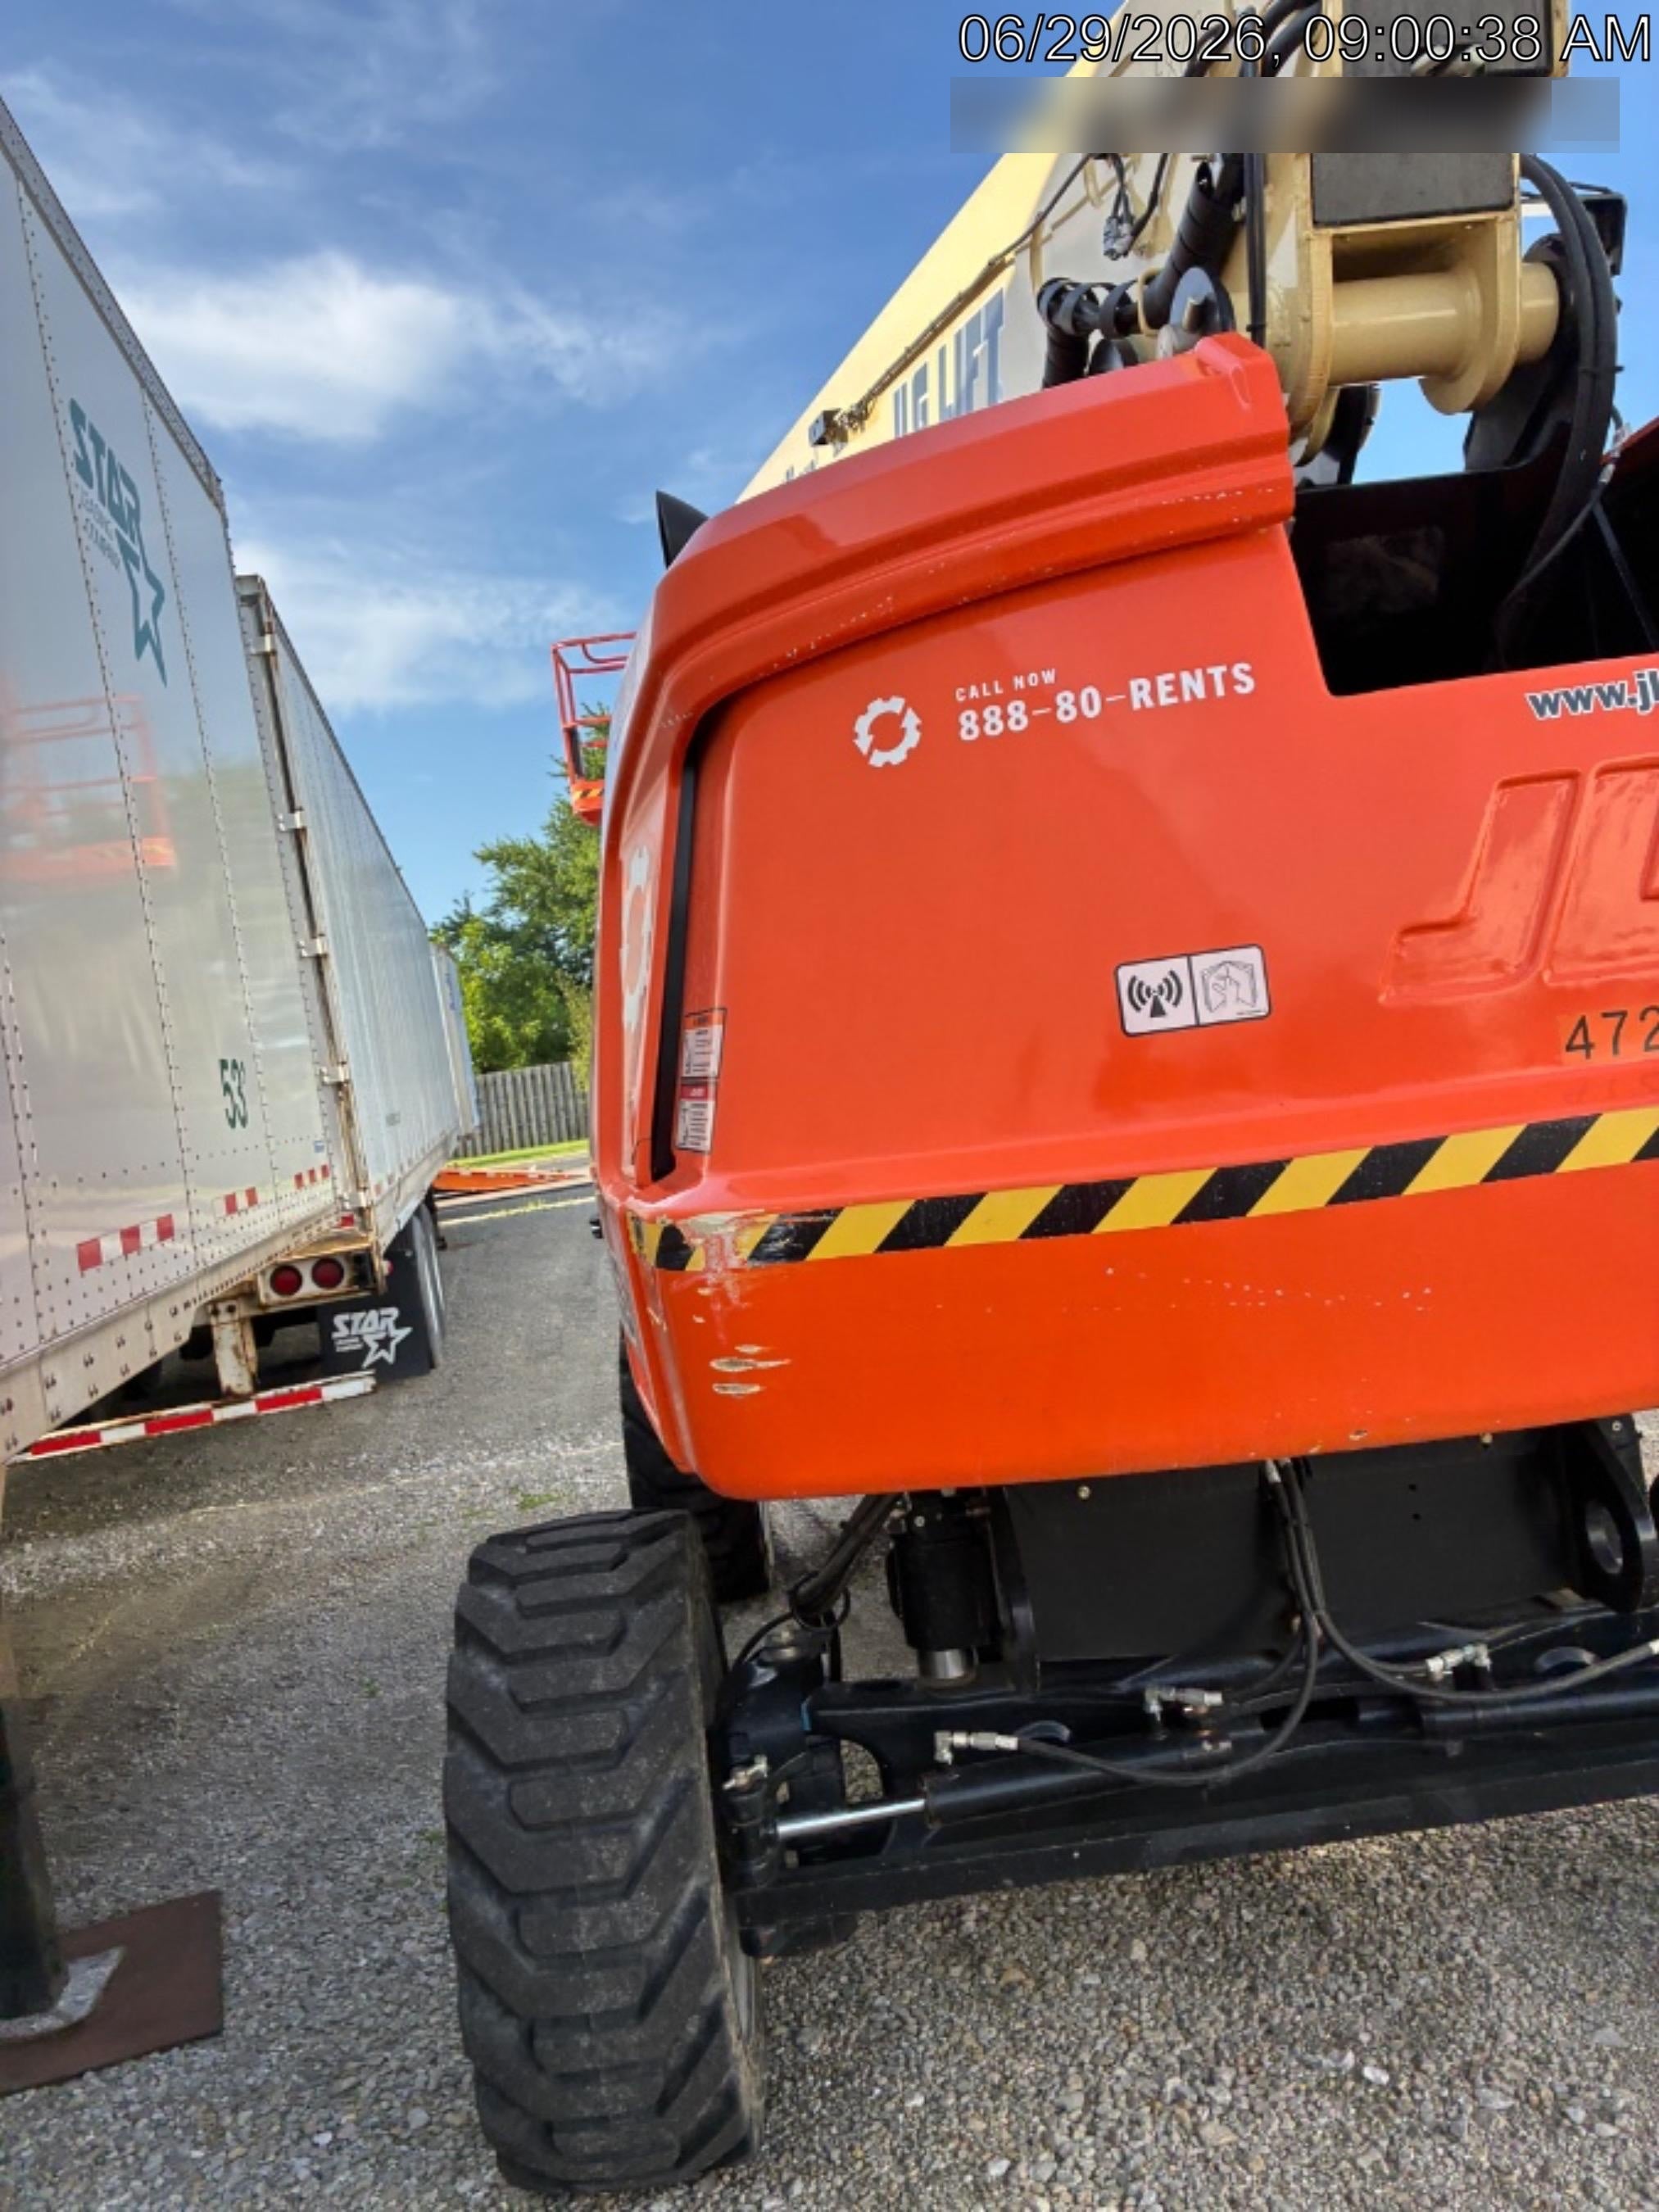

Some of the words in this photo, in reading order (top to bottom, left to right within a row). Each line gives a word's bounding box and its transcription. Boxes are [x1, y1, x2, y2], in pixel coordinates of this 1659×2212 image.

[70, 397, 140, 544] STAR
[955, 679, 1004, 702] CALL
[1013, 668, 1056, 691] NOW
[959, 662, 1256, 741] 888-80-RENTS
[1566, 1005, 1659, 1059] 472
[331, 1306, 400, 1339] STAR
